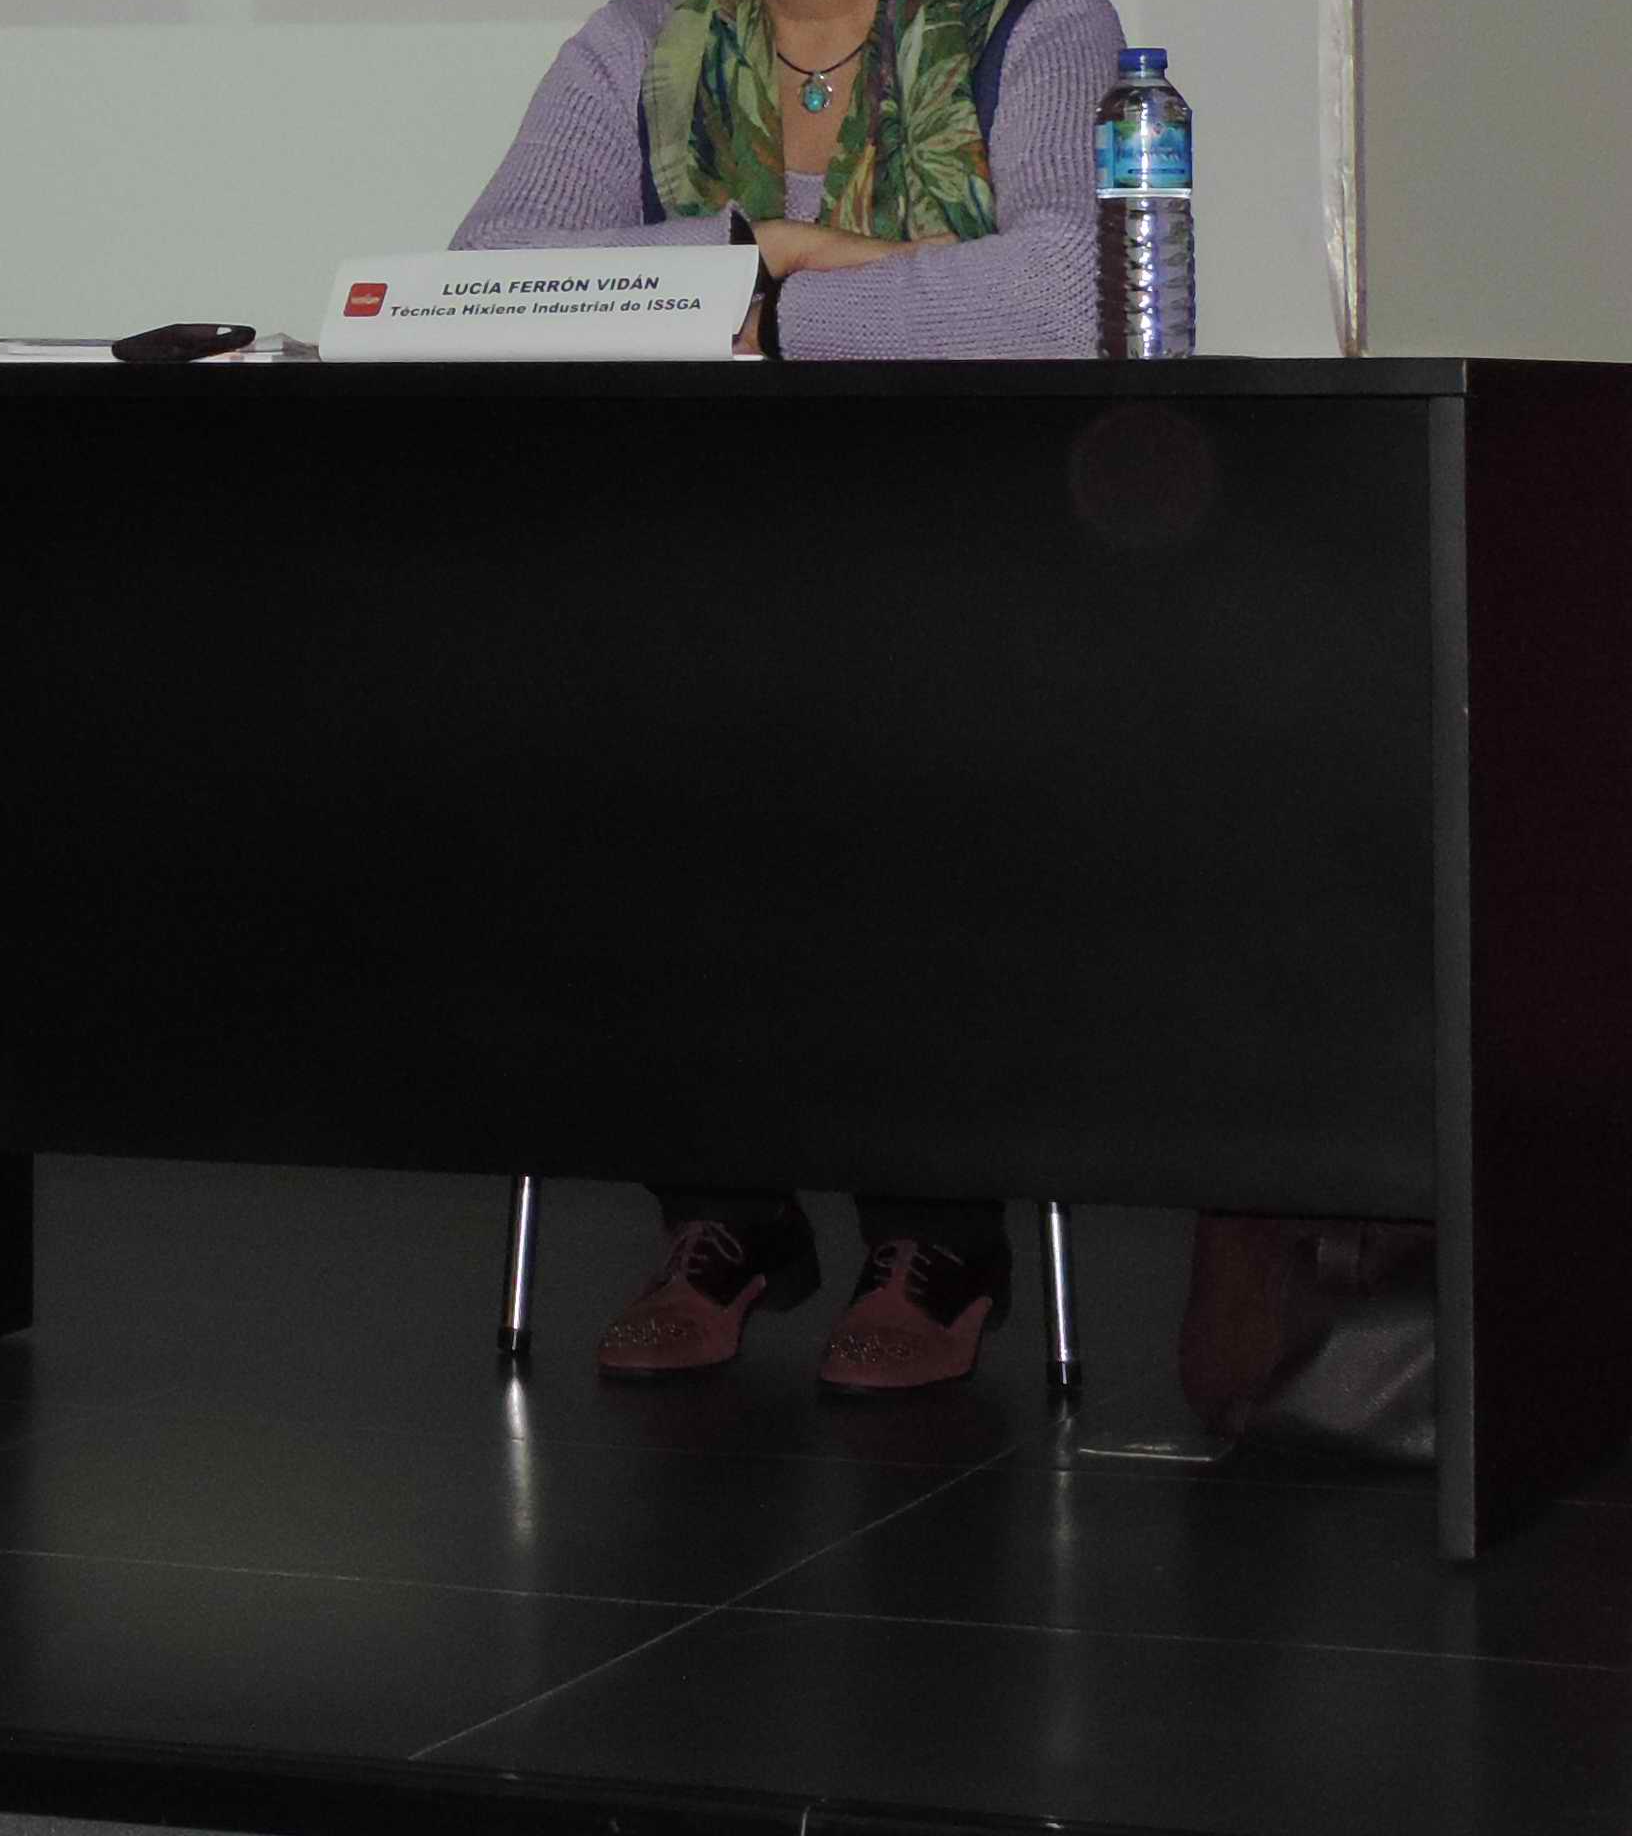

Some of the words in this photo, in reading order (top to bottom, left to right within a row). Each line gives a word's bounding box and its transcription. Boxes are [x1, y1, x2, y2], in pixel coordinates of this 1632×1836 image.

[442, 278, 502, 296] LUCÍA
[507, 276, 590, 293] FERRÓN
[596, 273, 660, 291] VIDÁN
[391, 304, 457, 317] Técnica
[461, 302, 527, 315] Hixiene
[532, 300, 615, 313] Industrial
[619, 299, 641, 312] do
[647, 297, 702, 311] ISSGA
